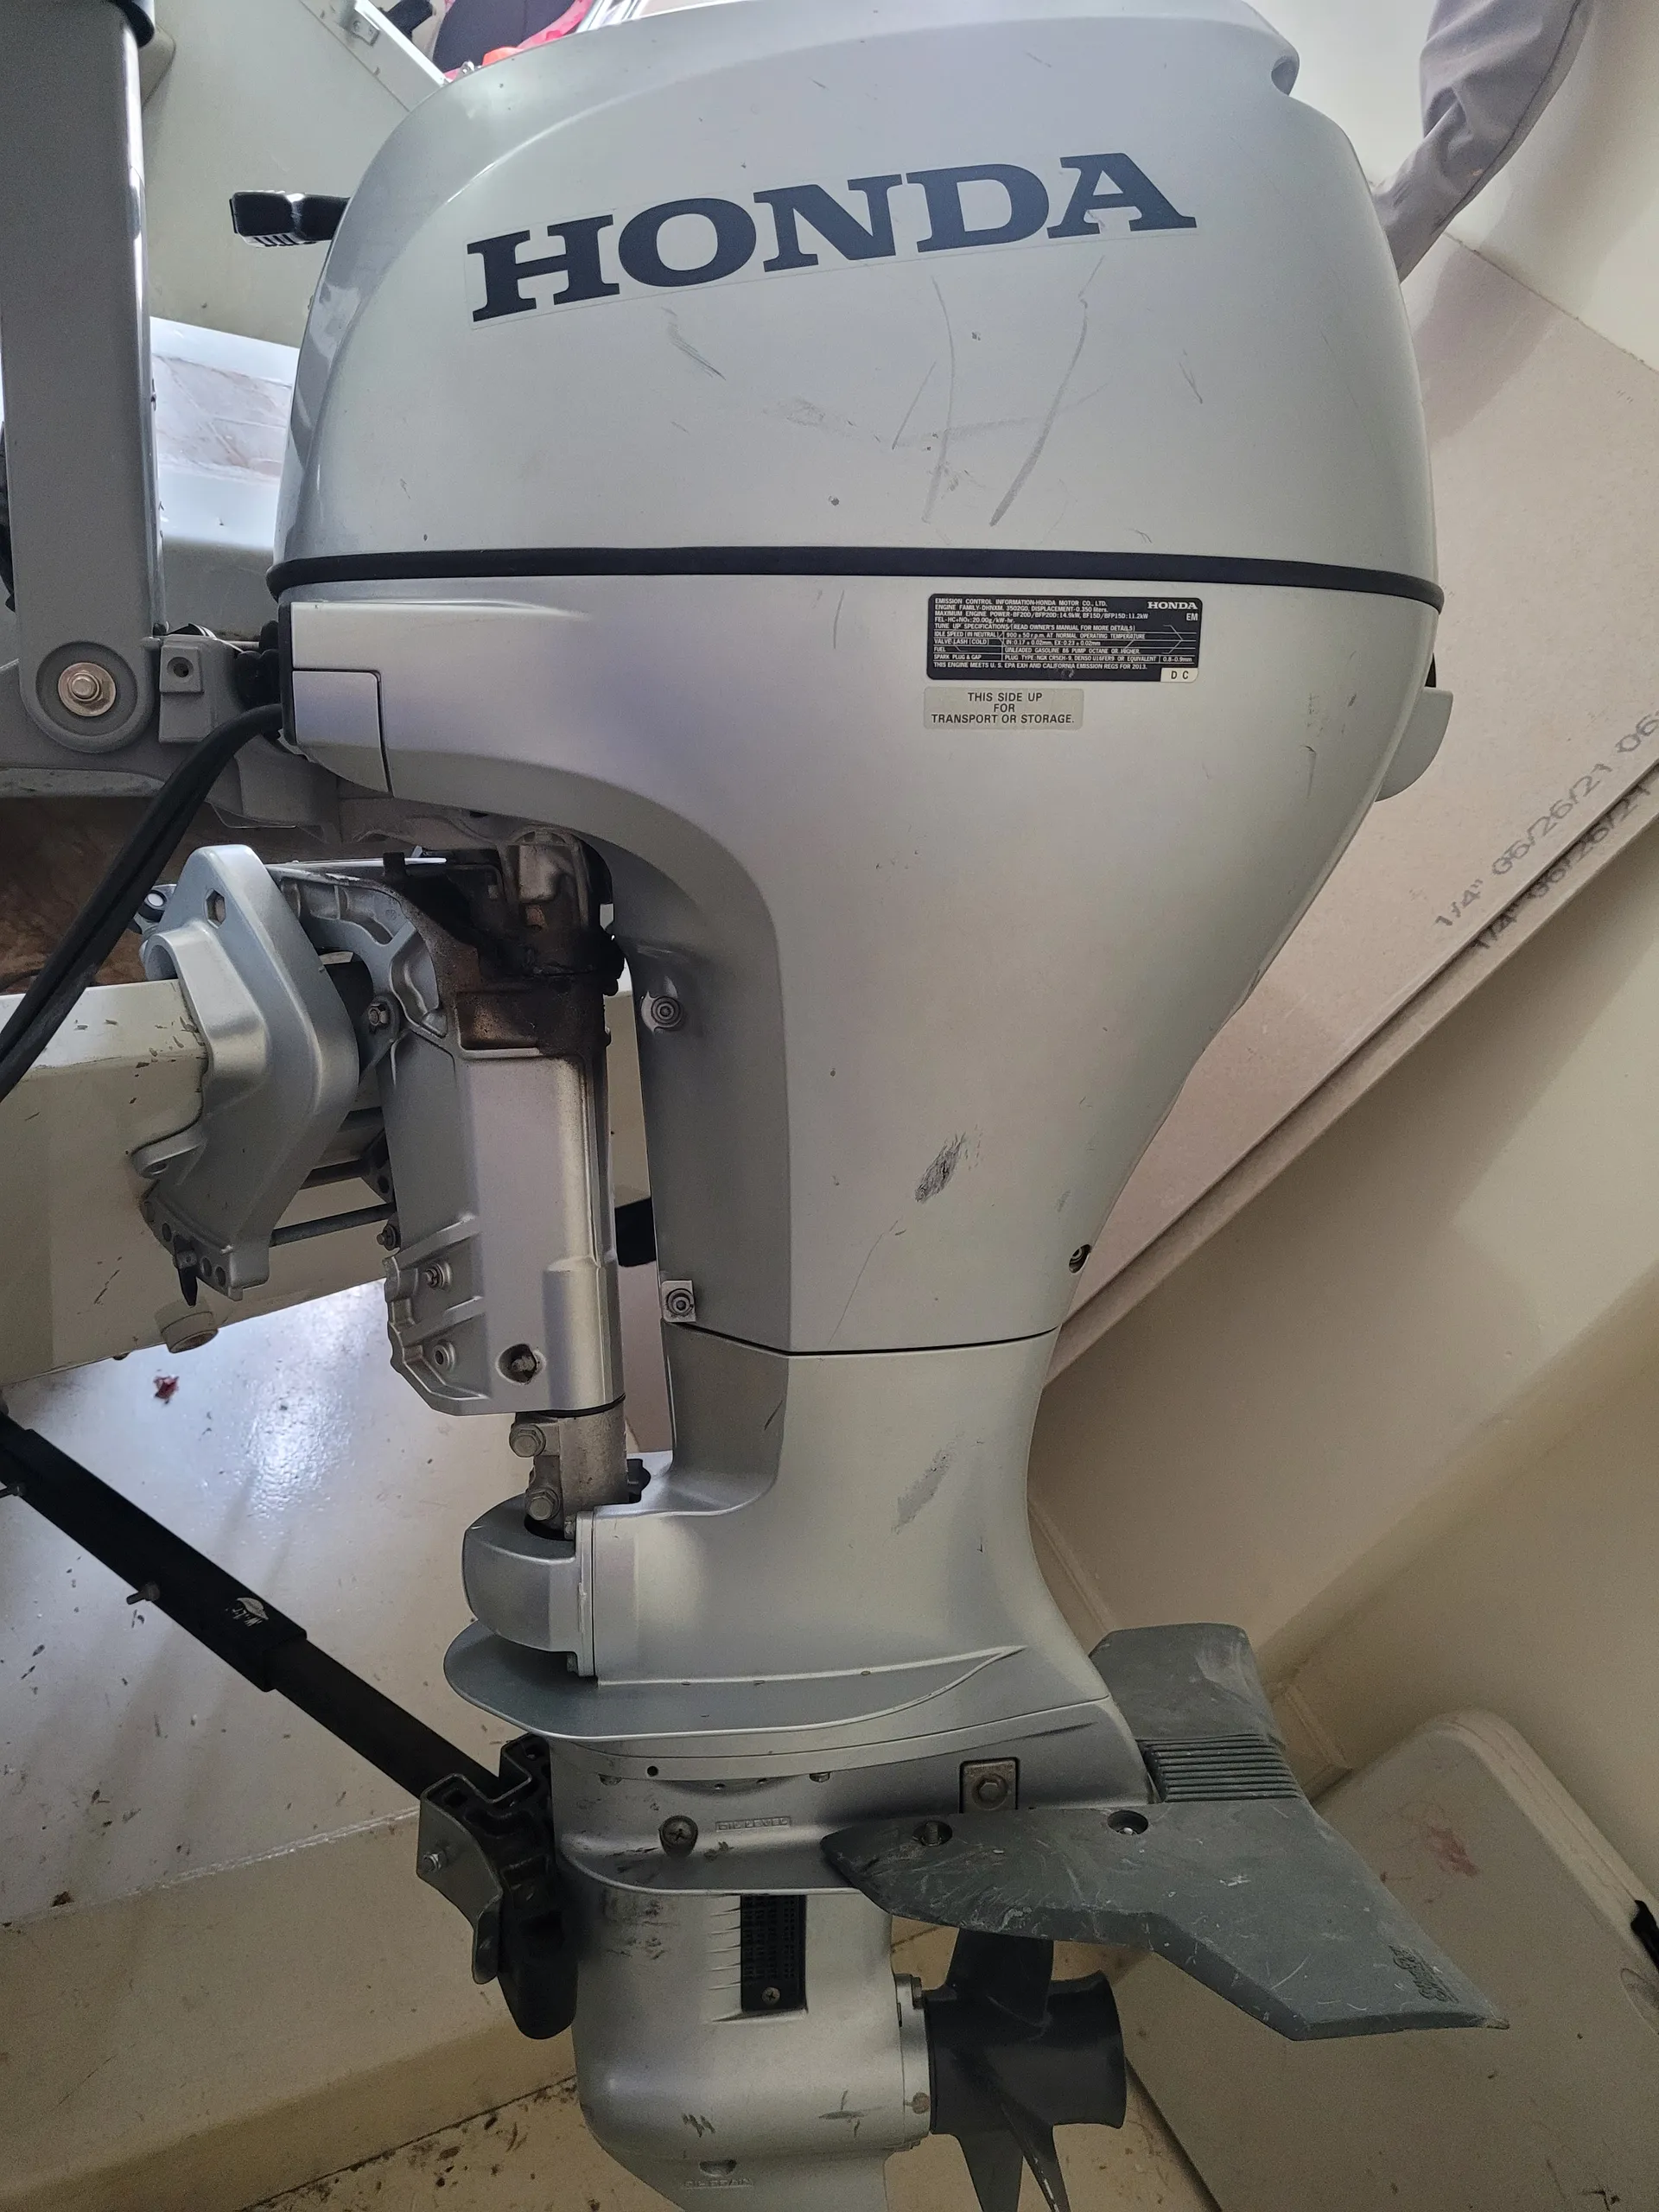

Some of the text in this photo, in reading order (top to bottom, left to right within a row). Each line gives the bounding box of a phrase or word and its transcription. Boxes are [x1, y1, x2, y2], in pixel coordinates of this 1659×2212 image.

[467, 153, 1196, 322] HONDA
[1147, 601, 1198, 610] HONDA
[1185, 613, 1198, 621] EM
[967, 692, 1043, 702] THIS SIDE UP
[993, 703, 1016, 713] FOR
[931, 714, 1075, 724] TRANSPORT OR STORAGE.
